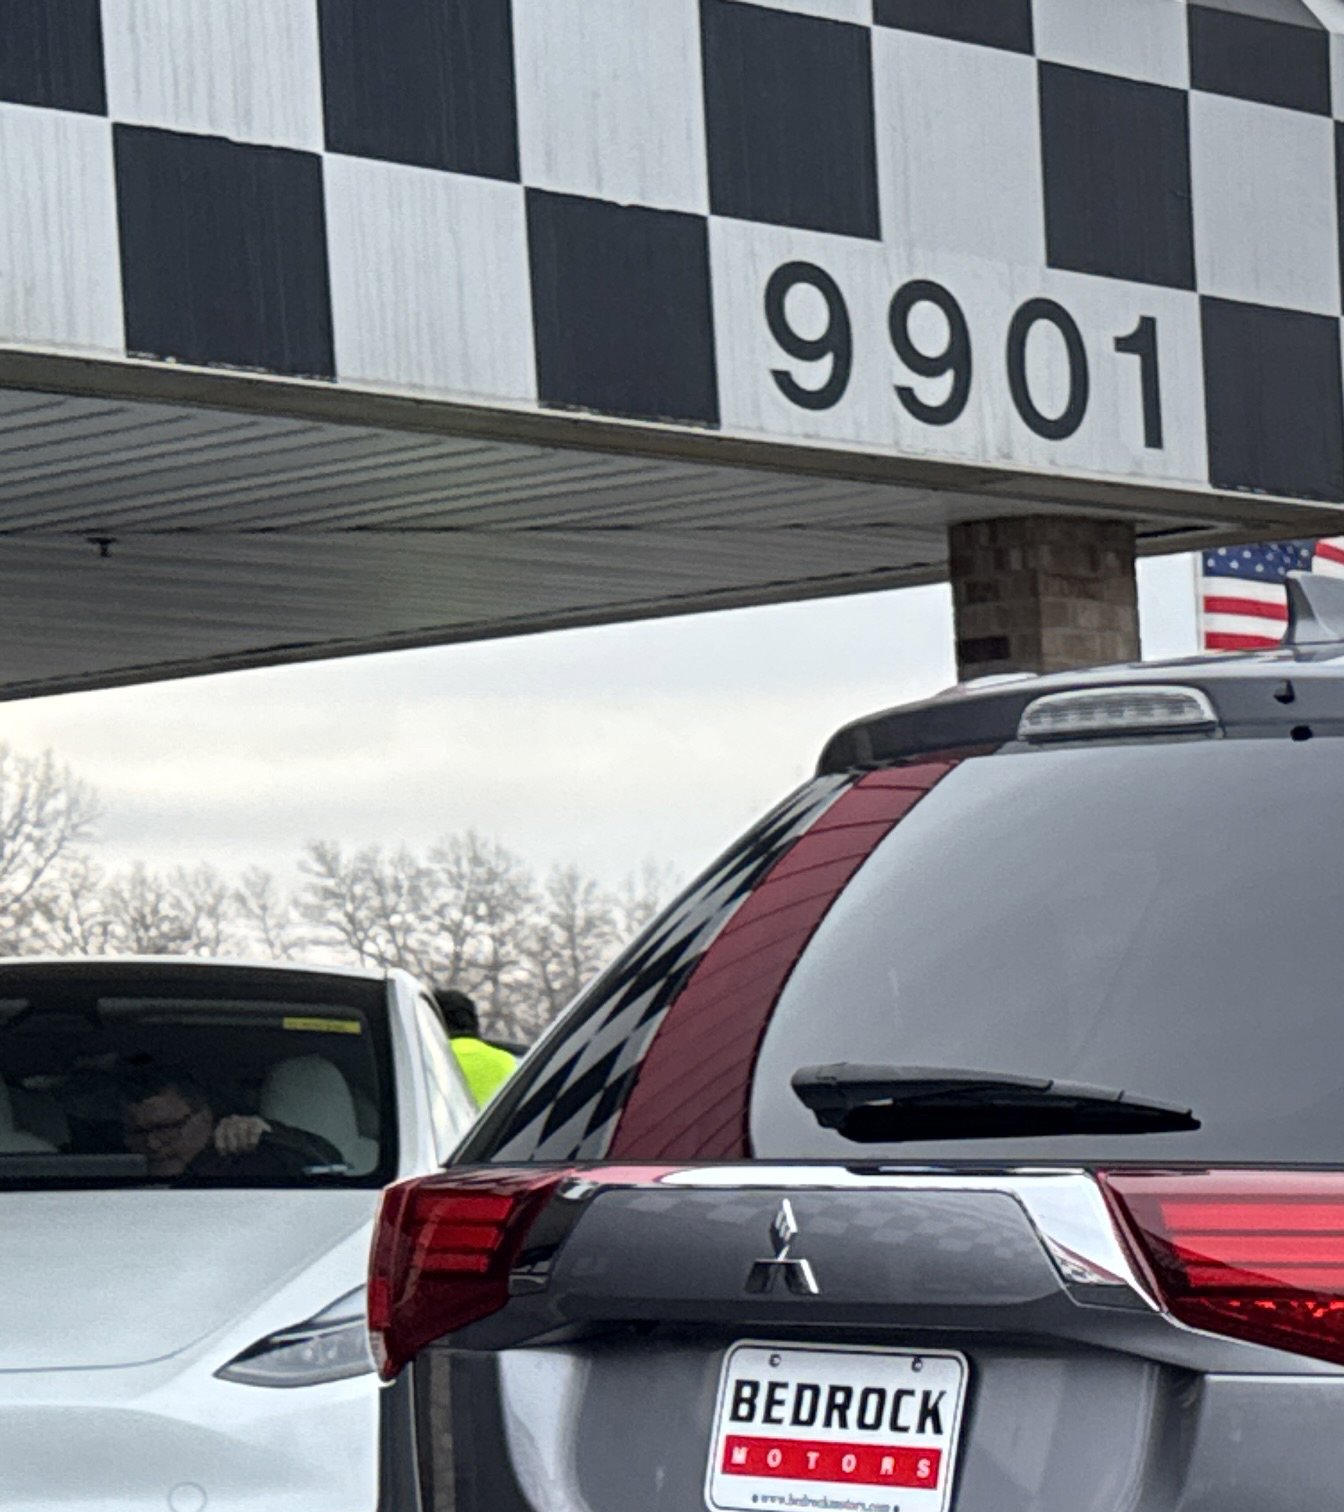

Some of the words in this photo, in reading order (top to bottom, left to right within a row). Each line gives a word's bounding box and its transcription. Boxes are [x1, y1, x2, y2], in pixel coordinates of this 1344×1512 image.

[764, 260, 1163, 450] 9901
[729, 1378, 948, 1435] BEDROCK
[731, 1447, 933, 1479] MOTORS
